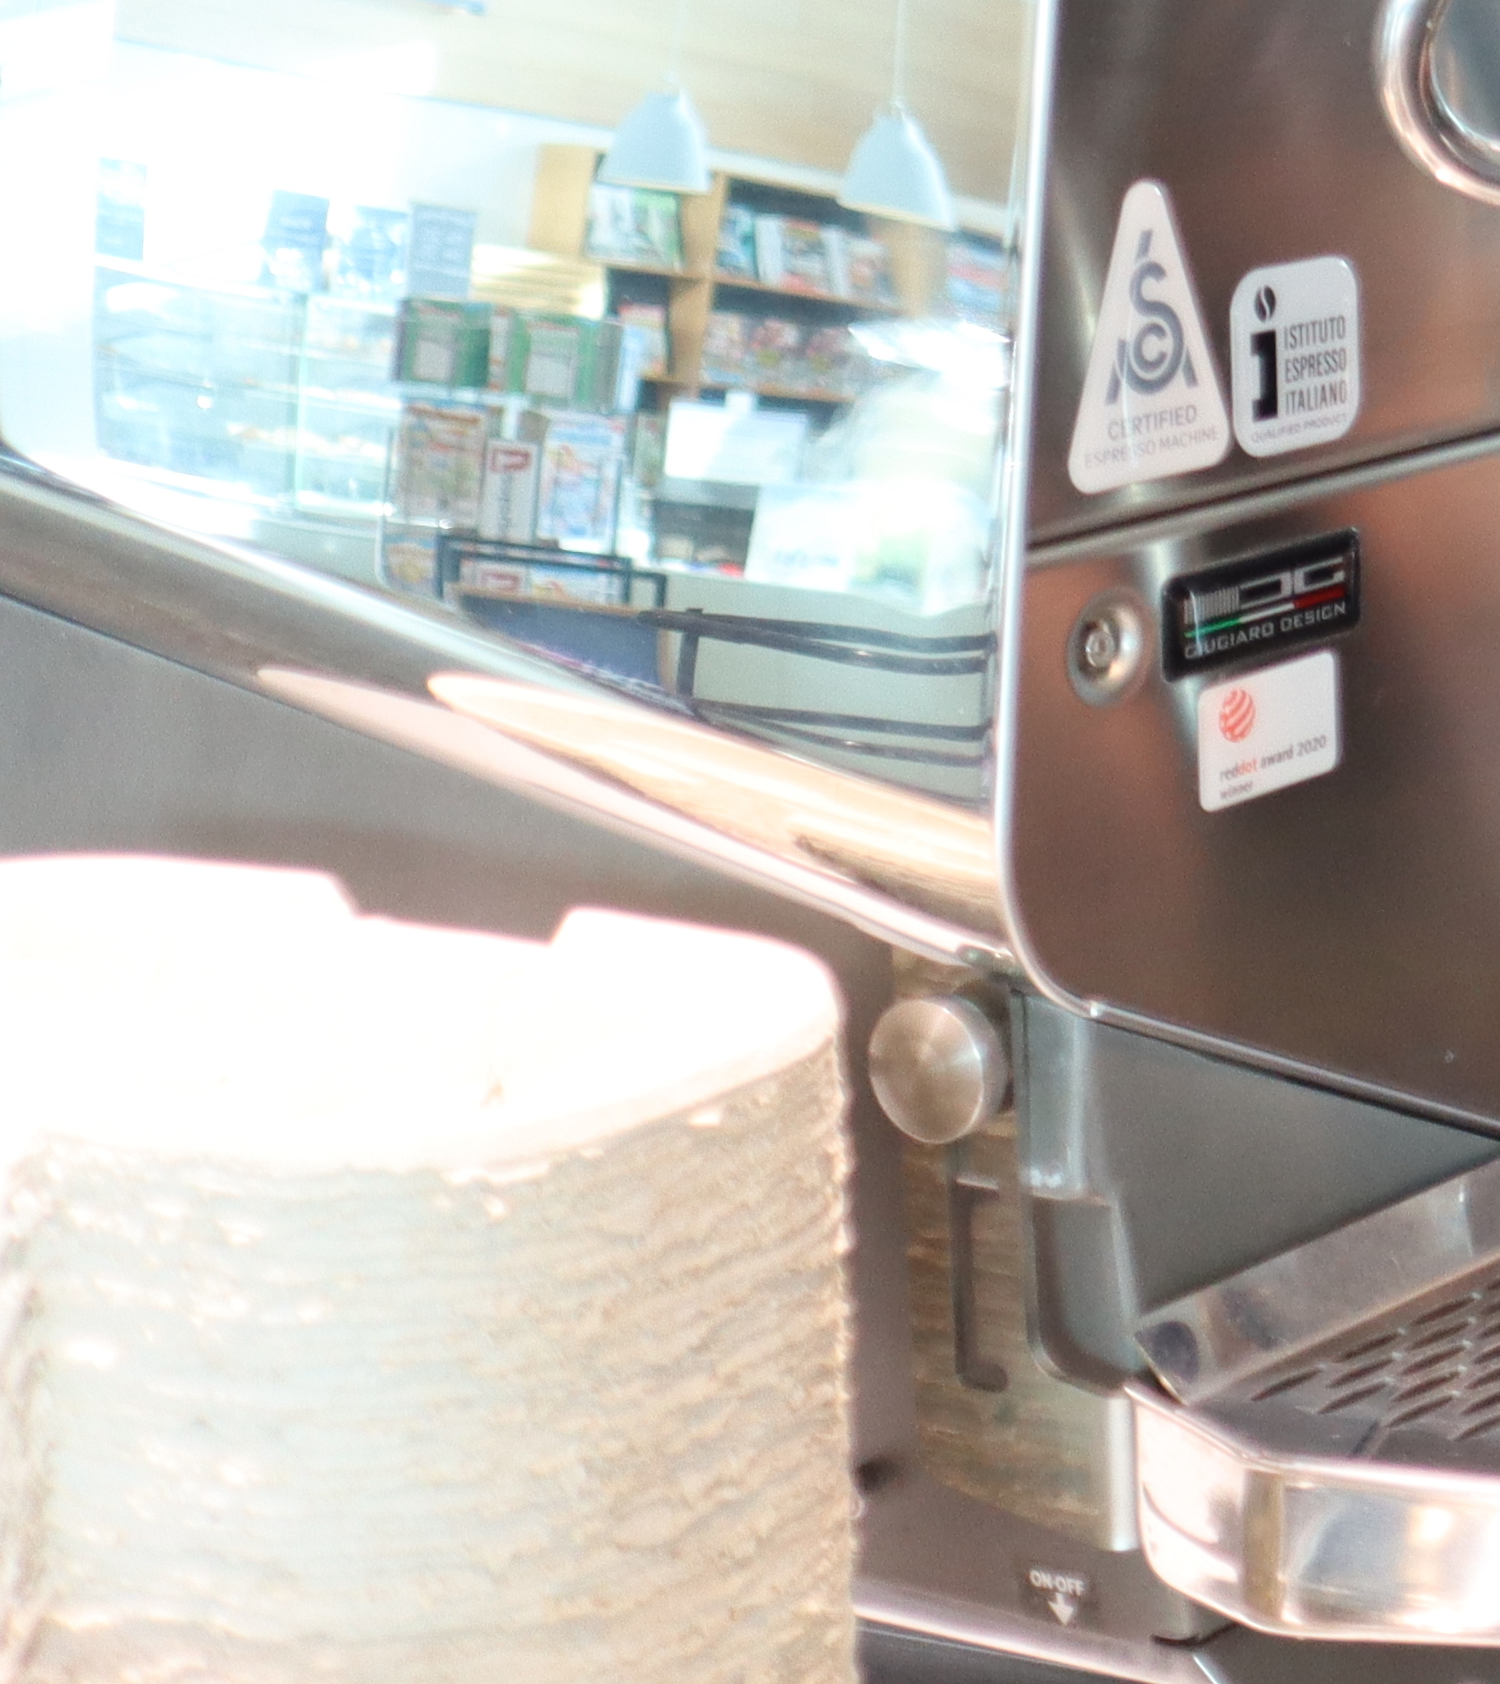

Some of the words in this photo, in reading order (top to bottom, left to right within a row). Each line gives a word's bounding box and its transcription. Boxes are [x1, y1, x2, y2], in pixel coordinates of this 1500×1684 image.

[1284, 314, 1346, 351] ISTITUTO
[1284, 348, 1347, 384] ESPRESSO
[1285, 379, 1348, 416] ITALIANO
[1161, 425, 1219, 452] MACHINE
[1279, 600, 1347, 634] DESIGN
[1260, 742, 1294, 770] award
[1296, 734, 1328, 758] 2020
